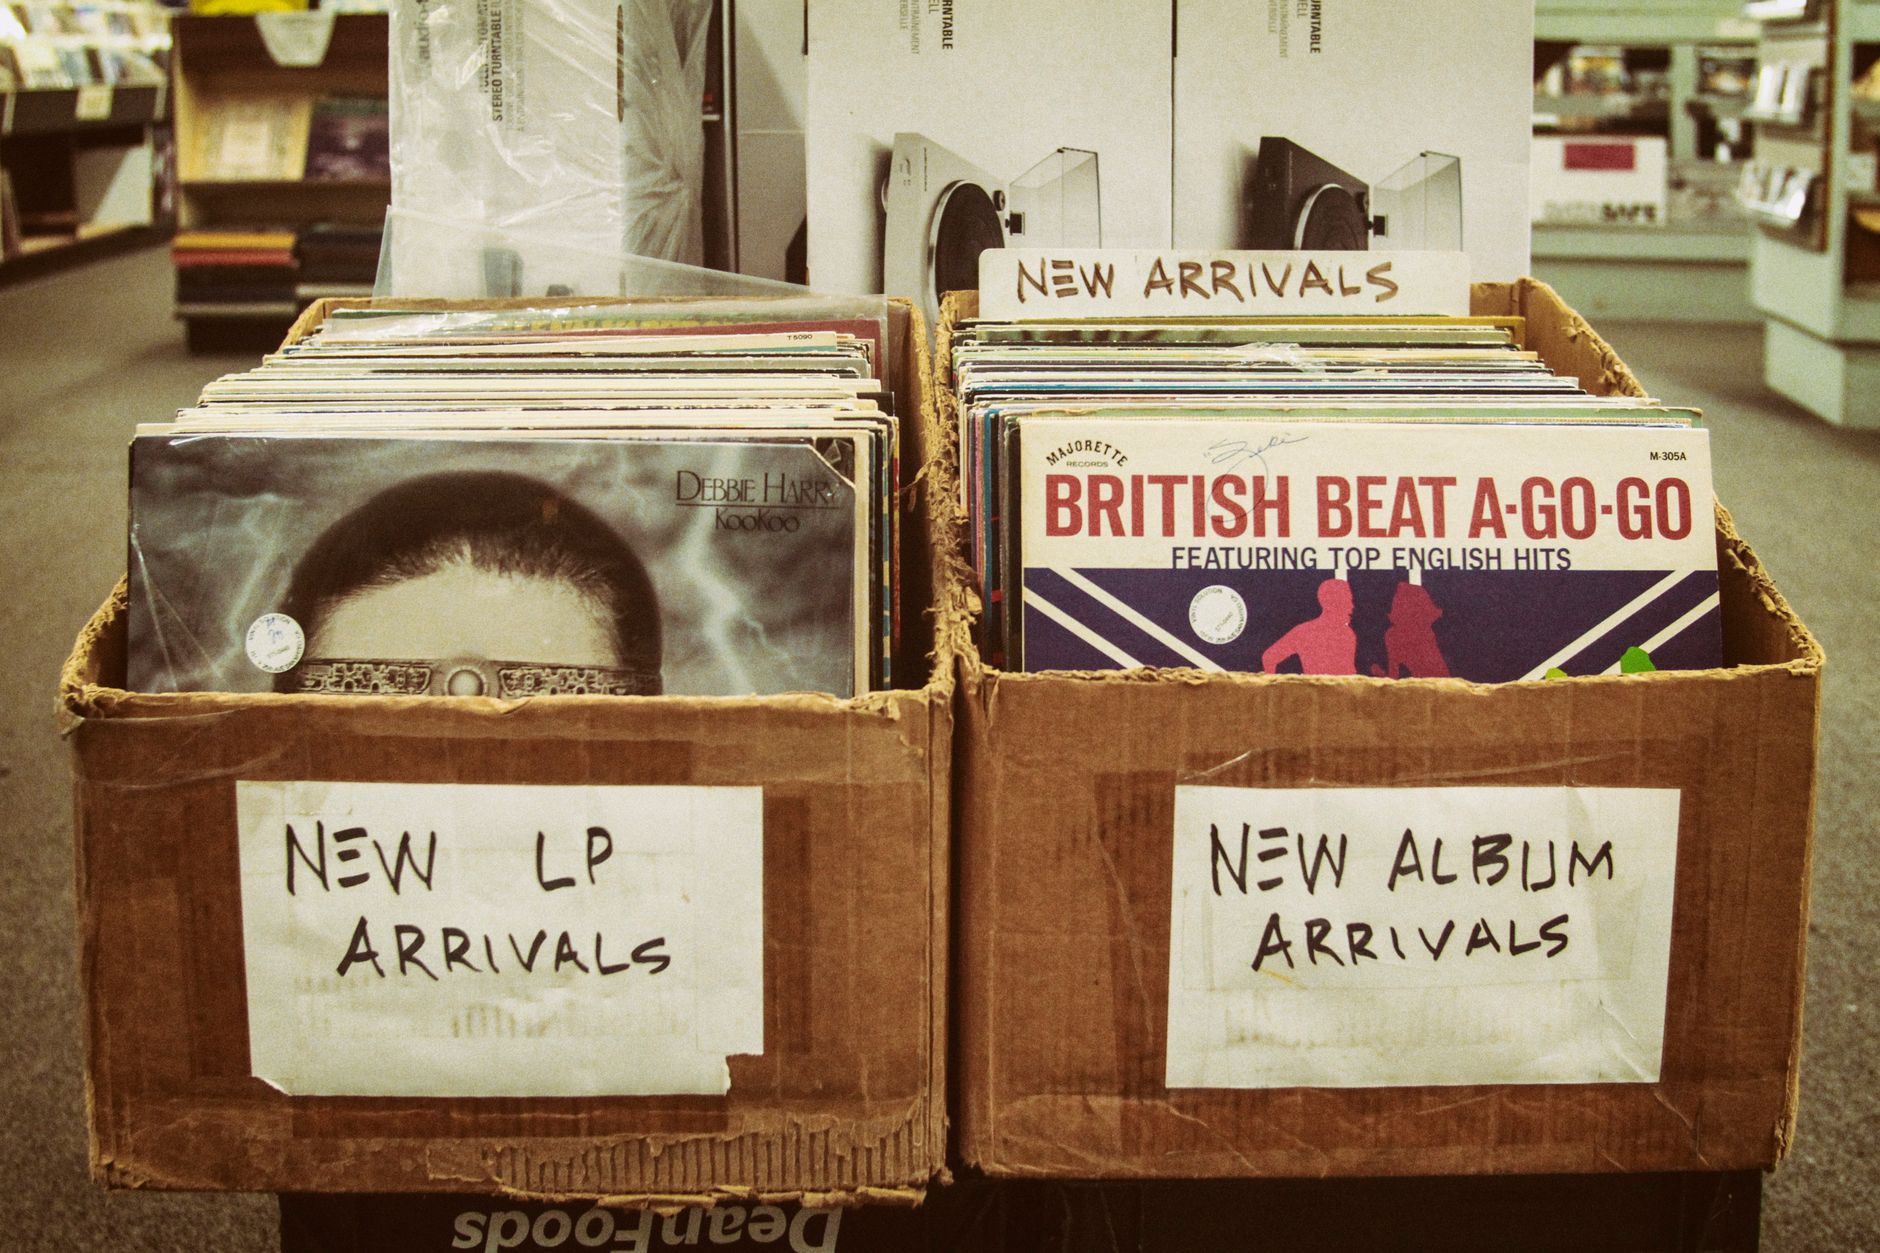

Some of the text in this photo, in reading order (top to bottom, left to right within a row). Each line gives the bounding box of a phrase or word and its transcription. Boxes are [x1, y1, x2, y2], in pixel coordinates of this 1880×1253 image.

[490, 10, 503, 75] TURNTABLE
[492, 79, 503, 122] STEREO
[1017, 257, 1398, 303] NEW ARRIVALS
[1045, 439, 1128, 467] MAJORETTE
[1649, 451, 1687, 461] M-305A
[1045, 473, 1290, 539] BRITISH
[1316, 475, 1458, 540] BEAT
[1467, 476, 1692, 541] A-GO-GO
[1172, 546, 1571, 571] FEATURING TOP ENGLISH HITS
[285, 820, 613, 896] NEW LP
[1210, 822, 1615, 896] NEW ALBUM
[336, 916, 671, 981] ARRIVALS
[1251, 912, 1570, 972] ARRIVALS
